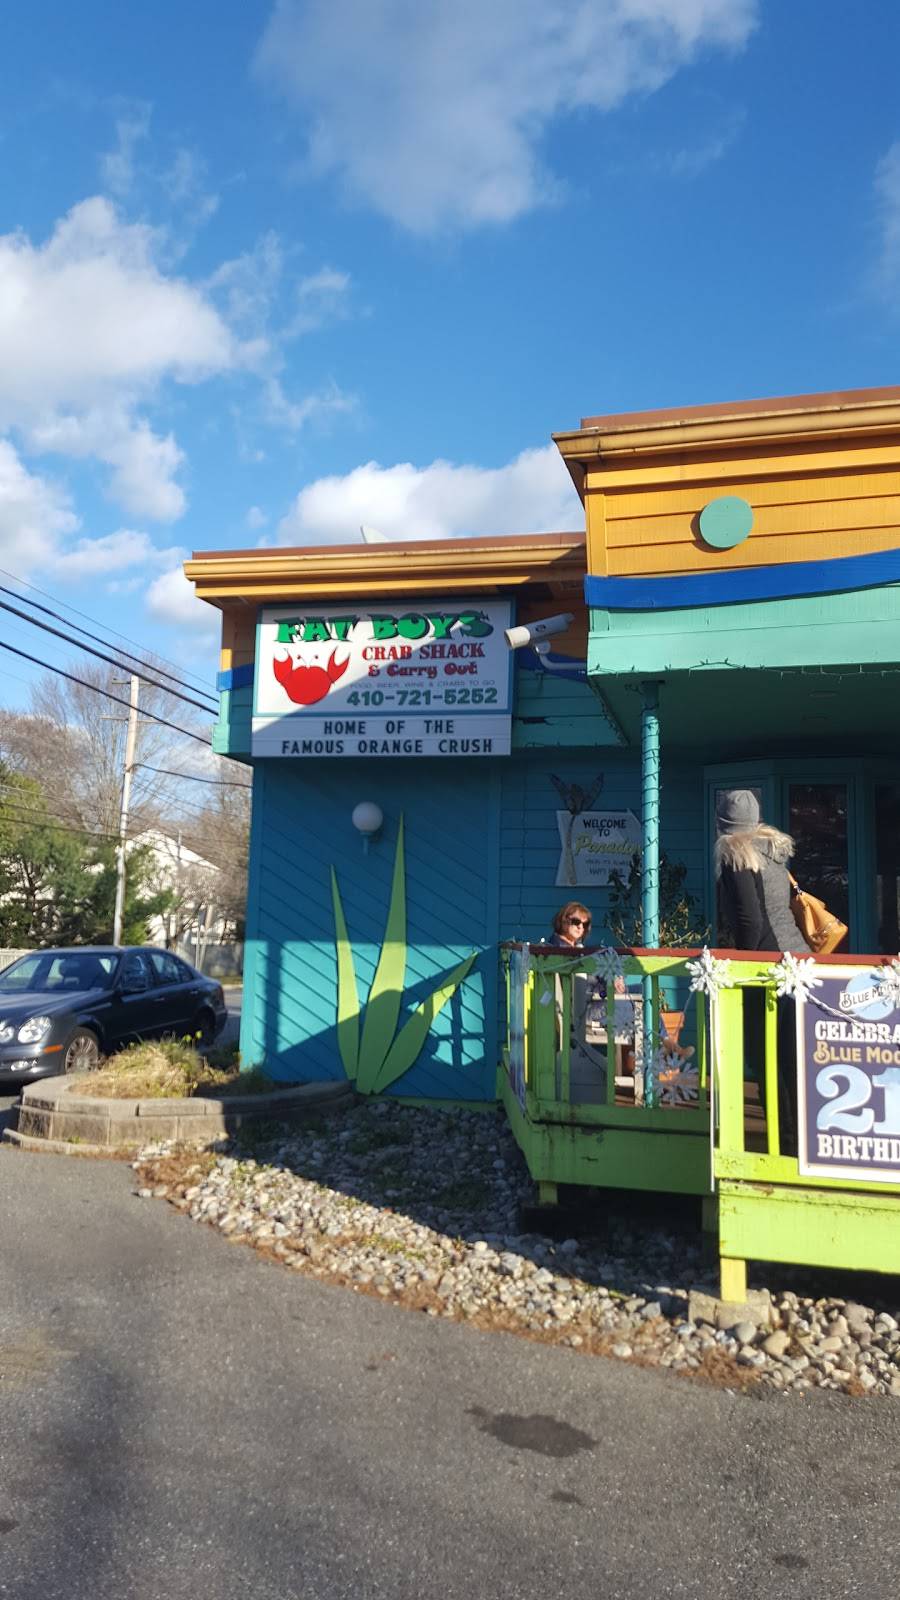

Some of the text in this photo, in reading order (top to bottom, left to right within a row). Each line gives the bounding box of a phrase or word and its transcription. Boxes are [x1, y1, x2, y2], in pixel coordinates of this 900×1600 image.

[274, 614, 359, 643] FAT
[362, 642, 485, 661] CRAB SHACK
[368, 661, 478, 679] & Carry Out
[347, 687, 498, 706] 410-721-5252
[323, 719, 454, 735] HOME OF THE
[281, 738, 493, 755] FAMOUS ORANGE CRUSH
[583, 819, 627, 829] WELCOME
[599, 828, 610, 837] TO
[841, 991, 870, 1009] BLUE
[813, 1041, 862, 1065] BLUE
